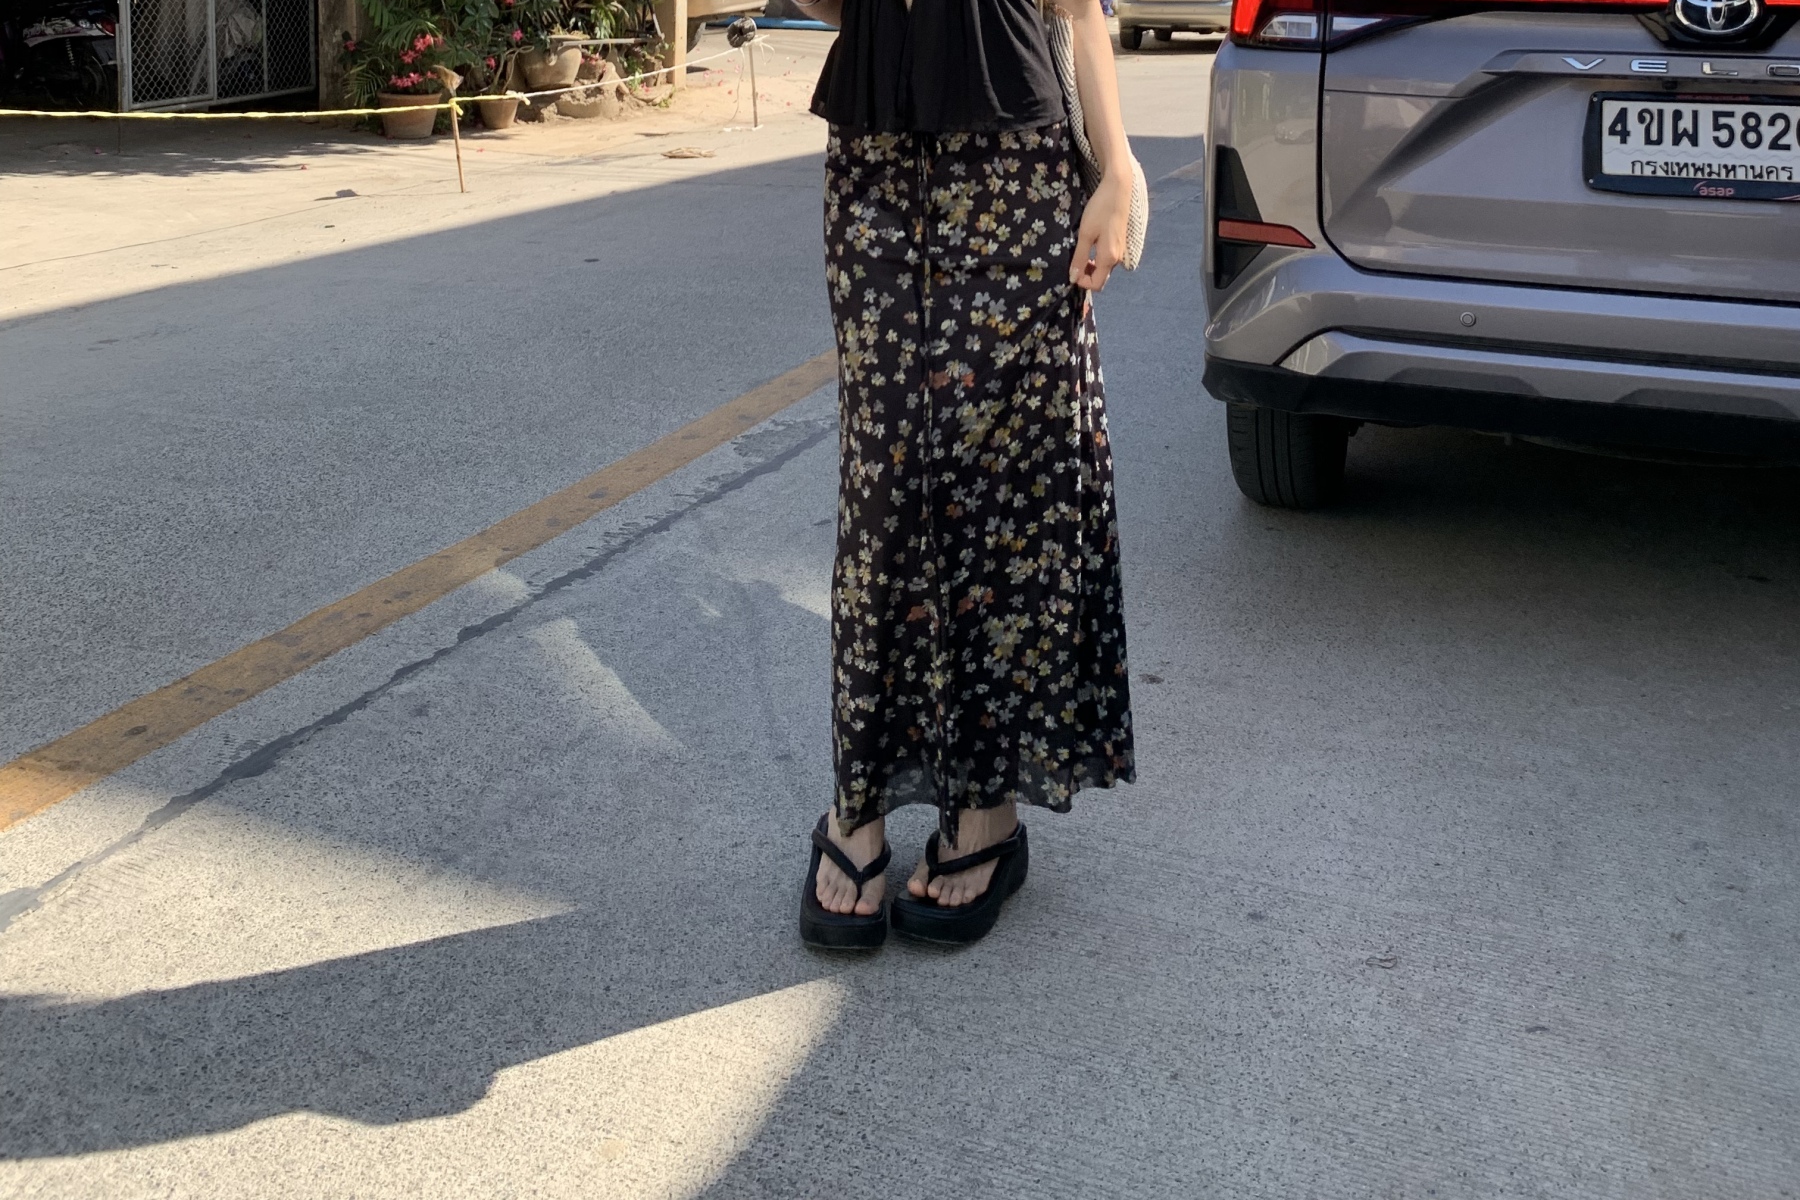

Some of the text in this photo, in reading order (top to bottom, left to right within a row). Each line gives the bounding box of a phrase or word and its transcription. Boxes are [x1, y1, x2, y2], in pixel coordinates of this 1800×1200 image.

[1608, 106, 1800, 152] 4ขผ 582
[1631, 159, 1793, 181] กรงเทพมหานคร
[1698, 185, 1735, 198] asap
